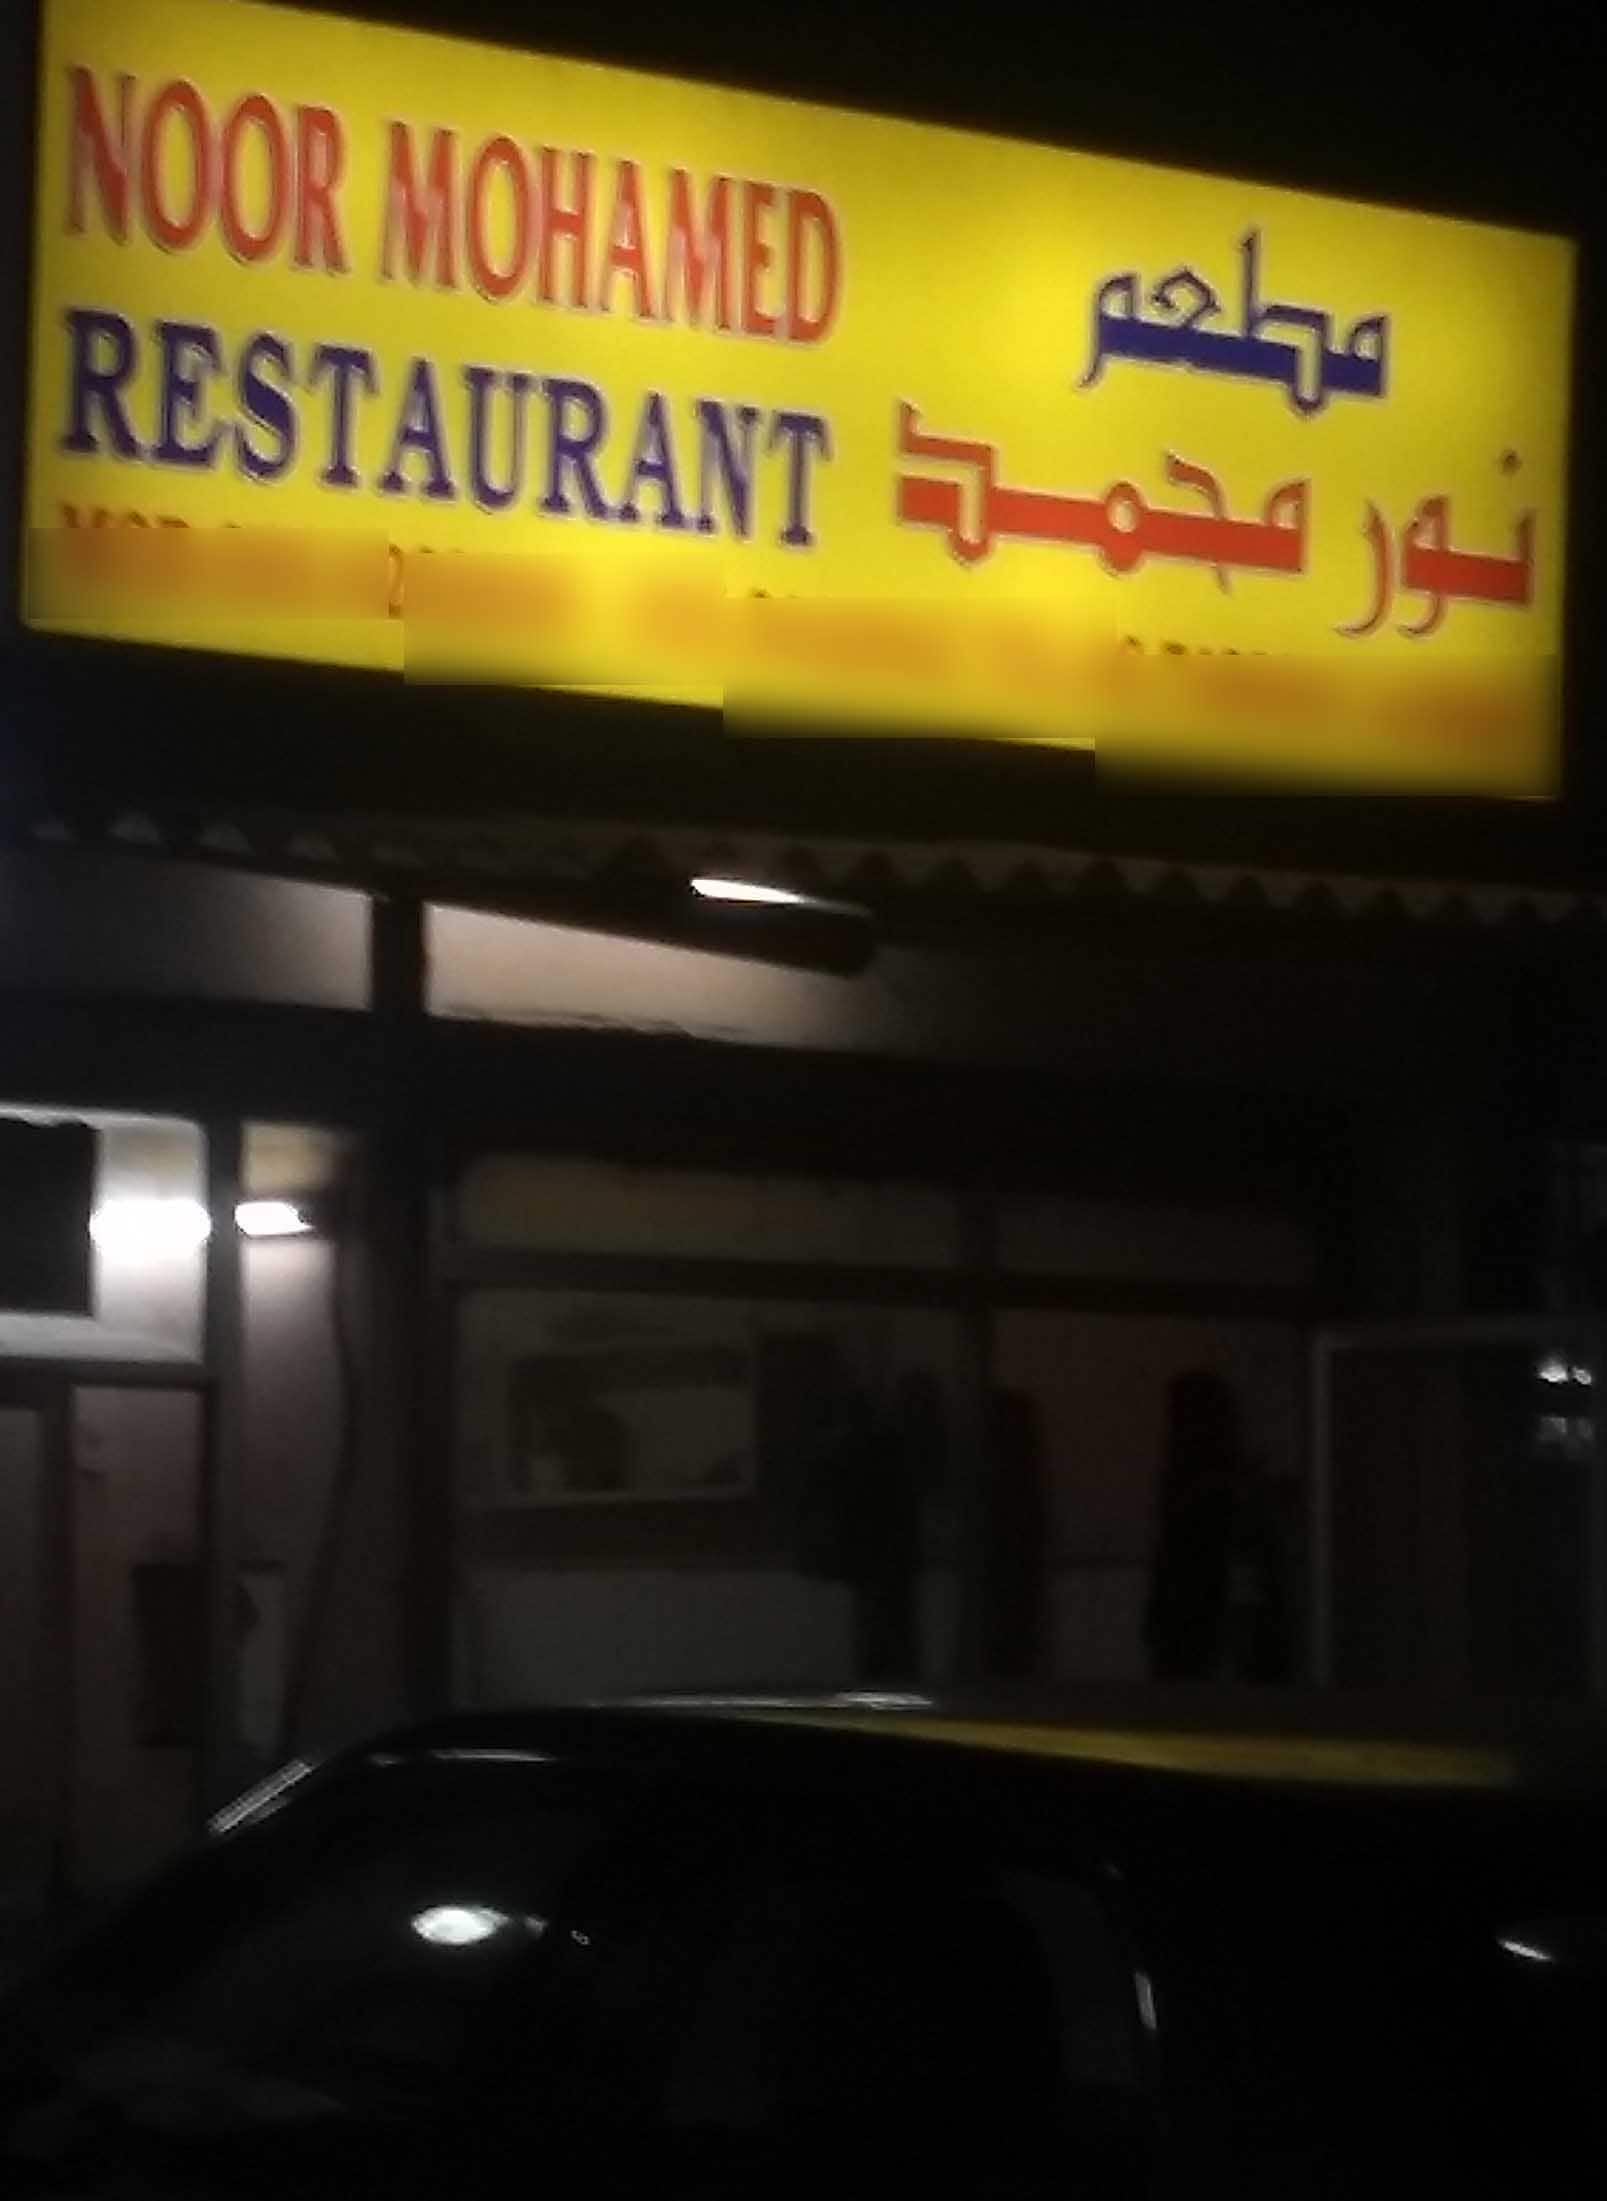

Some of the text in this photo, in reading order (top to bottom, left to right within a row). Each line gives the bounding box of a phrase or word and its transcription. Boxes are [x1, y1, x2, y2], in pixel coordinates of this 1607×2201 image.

[66, 65, 842, 343] NOOR MOHAMED
[1080, 228, 1390, 416] مطعم
[60, 307, 833, 547] RESTAURANT
[897, 400, 1537, 637] نور محمد
